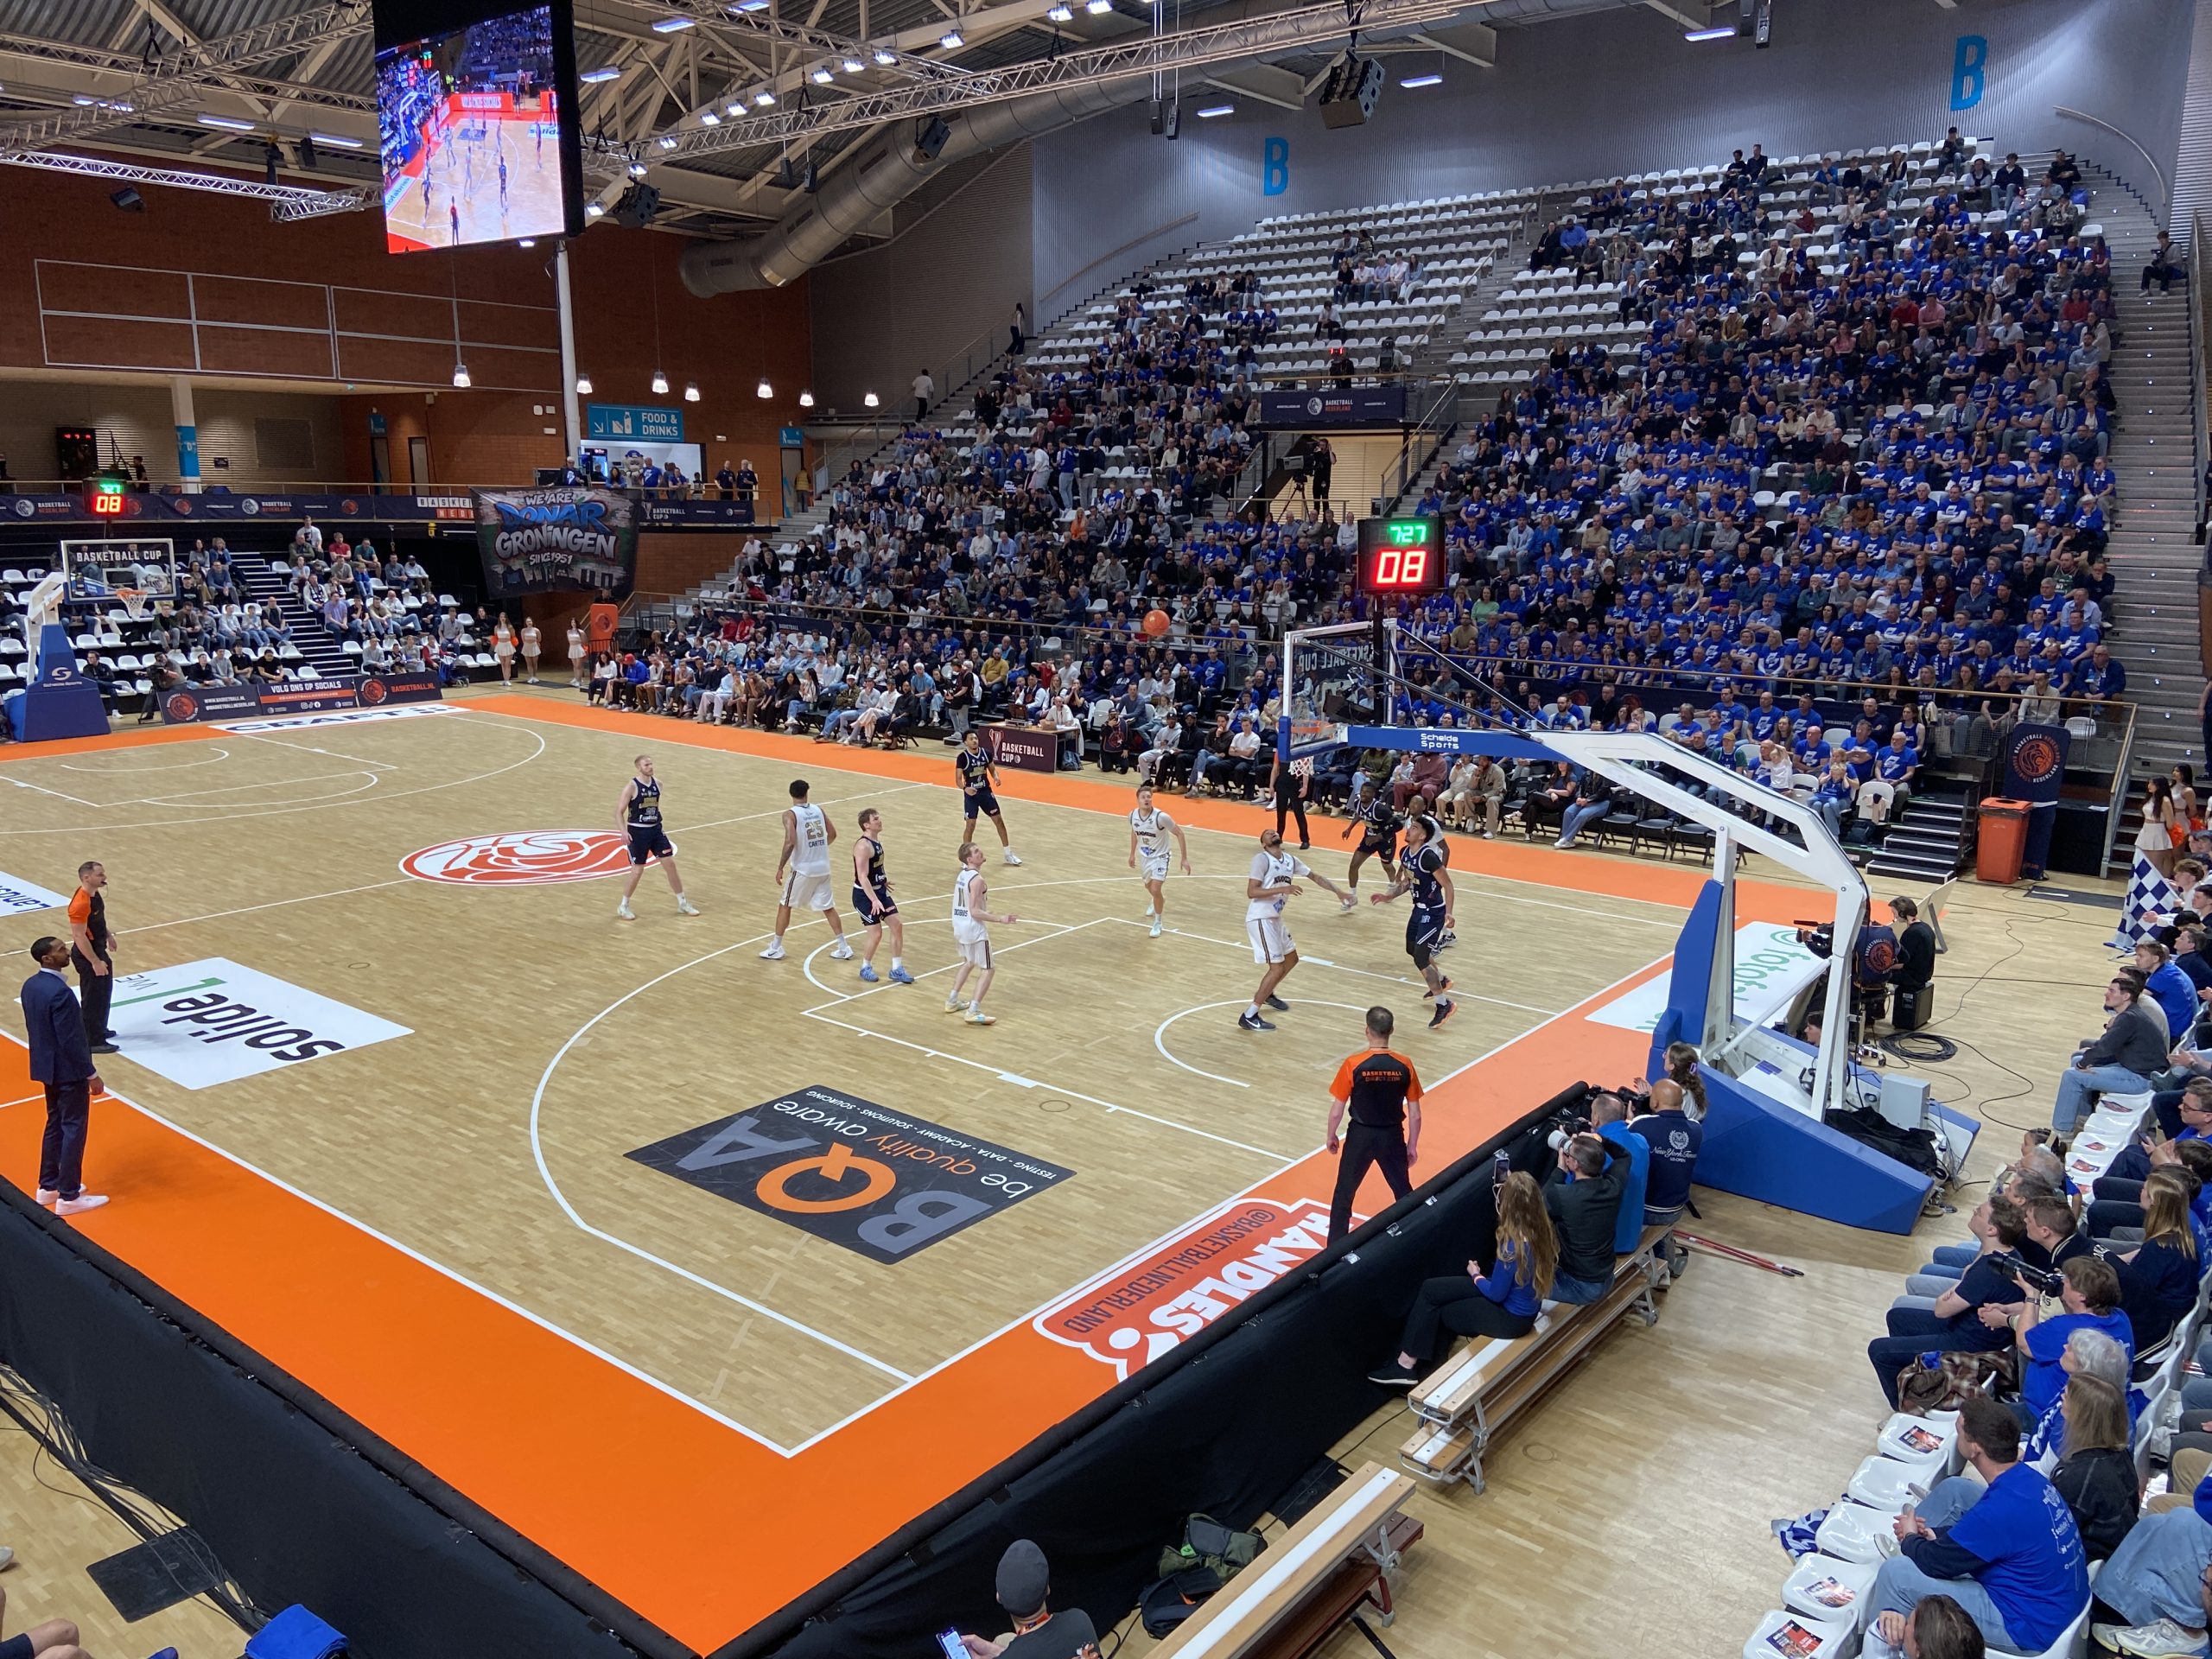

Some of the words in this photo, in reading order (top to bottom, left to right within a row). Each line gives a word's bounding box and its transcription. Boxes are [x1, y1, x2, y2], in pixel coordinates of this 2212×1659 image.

[1950, 35, 1988, 111] B
[1264, 137, 1290, 197] B
[641, 412, 667, 423] FOOD
[670, 414, 677, 423] &
[642, 424, 678, 436] DRINKS
[95, 495, 122, 512] 08
[524, 495, 545, 505] WE
[546, 493, 574, 504] ARE
[76, 551, 140, 563] BASKETBALL
[143, 550, 162, 560] CUP
[551, 553, 573, 564] 1951
[1376, 550, 1427, 583] 08
[271, 684, 289, 693] VOLG
[290, 683, 303, 691] ONS
[315, 681, 341, 690] SOCIALS
[391, 683, 435, 693] BASKETBALL.NL
[226, 710, 403, 731] CRAFT
[1421, 733, 1459, 742] Schelde
[1421, 741, 1459, 750] Sports
[1001, 742, 1044, 757] BASKETBALL
[1001, 753, 1014, 763] CUP
[804, 820, 824, 840] 25
[160, 993, 346, 1061] solide
[806, 1090, 857, 1110] SOURCING
[773, 1101, 868, 1136] aware
[860, 1109, 913, 1129] SOLUTIONS
[917, 1129, 972, 1149] ACADEMY
[864, 1134, 977, 1175] quality
[977, 1148, 1008, 1163] DATA
[1013, 1161, 1058, 1179] TESTING
[980, 1173, 1034, 1199] be
[1063, 1208, 1277, 1333] @BASKETBALLNEDERLAND
